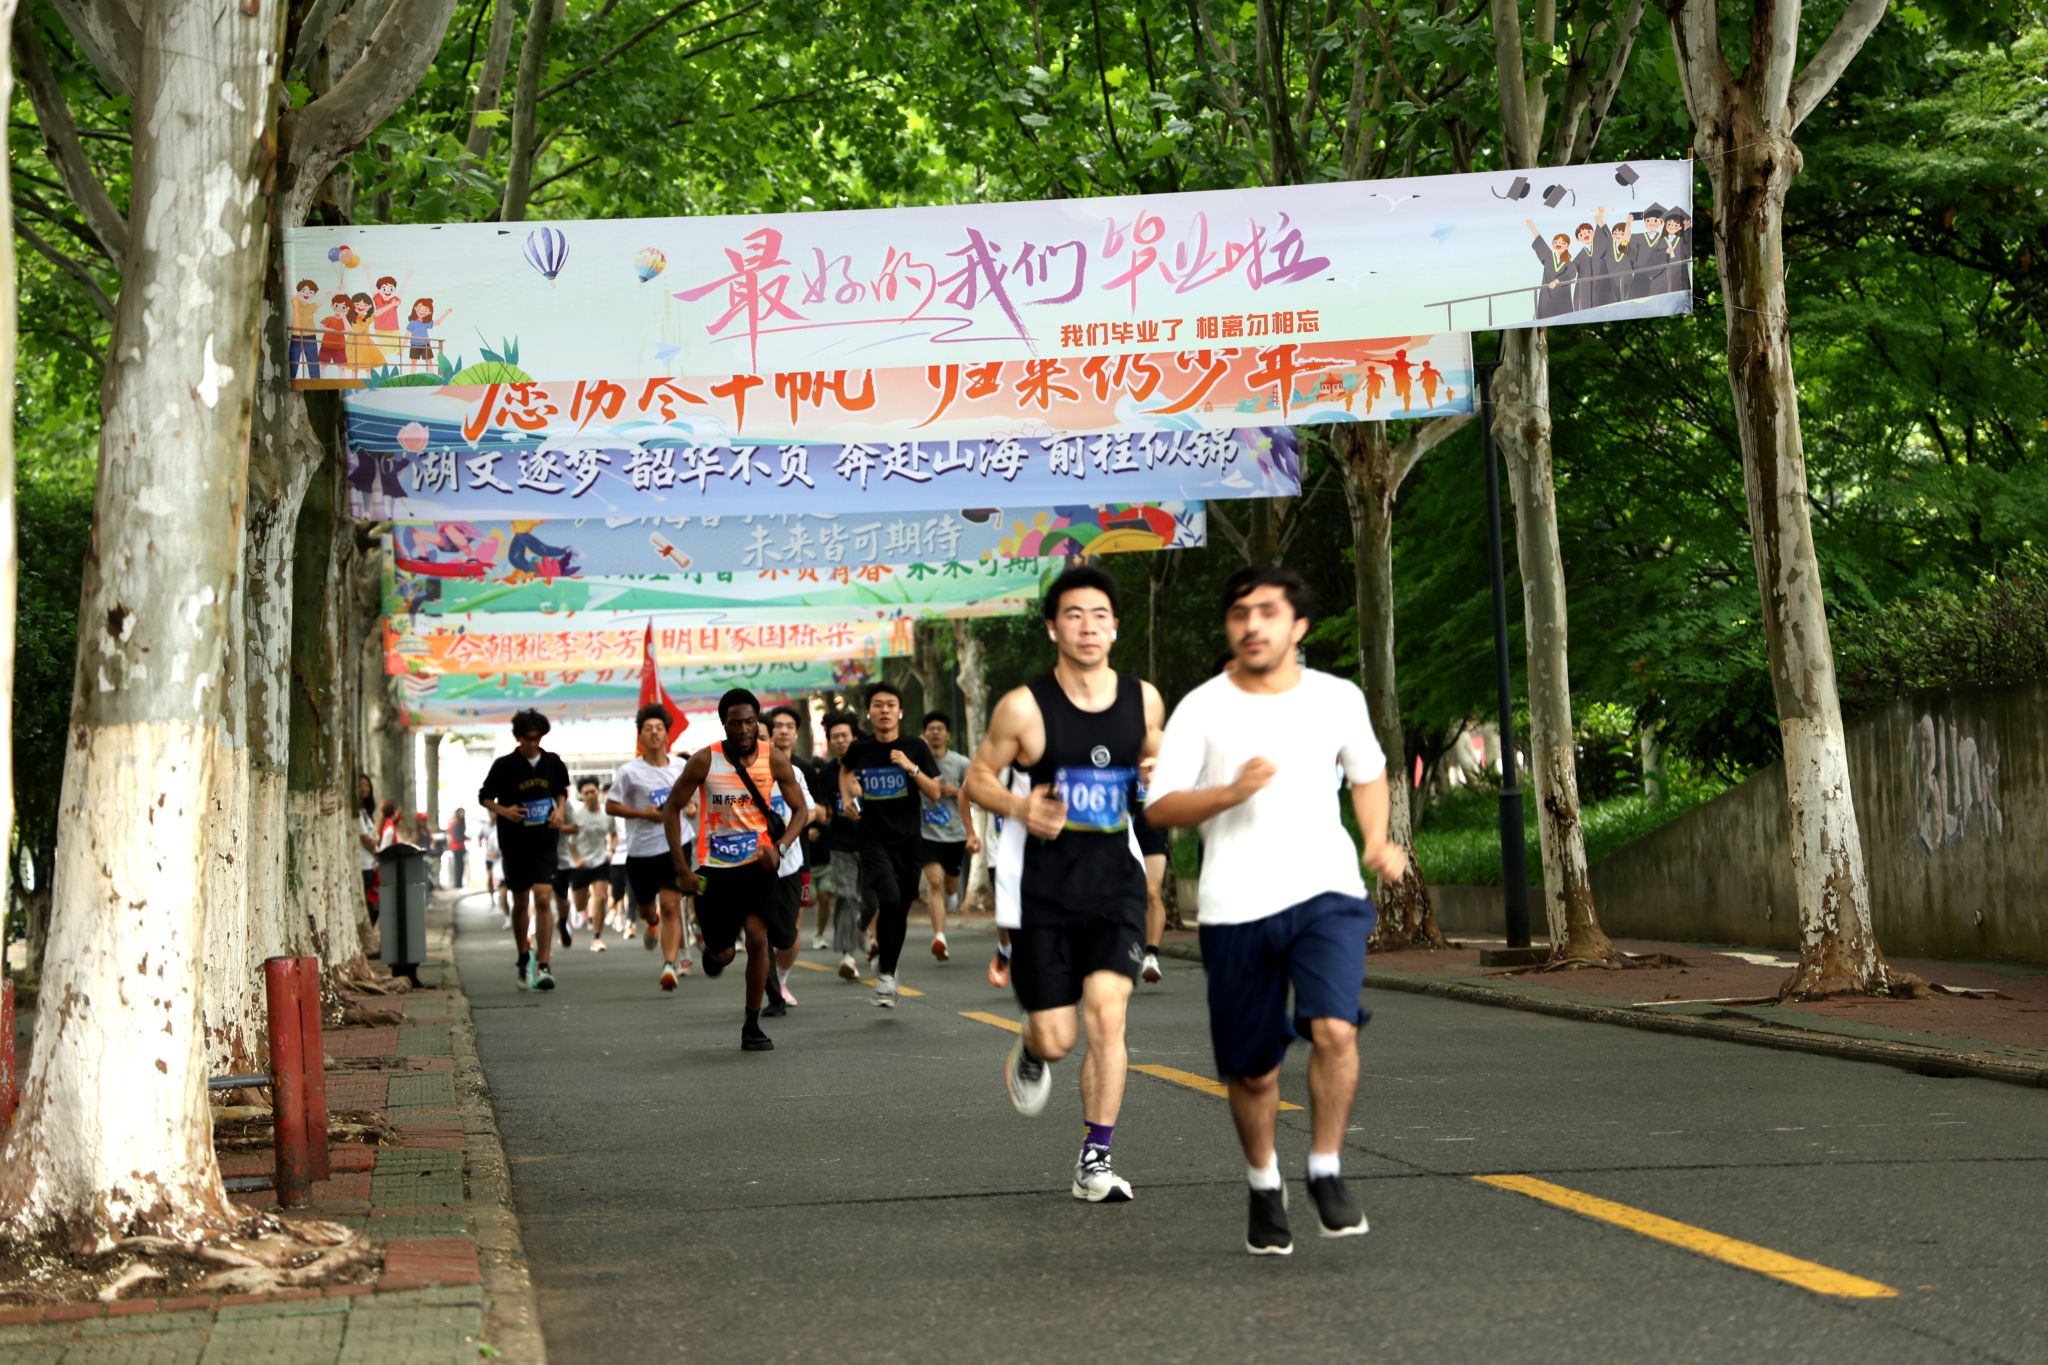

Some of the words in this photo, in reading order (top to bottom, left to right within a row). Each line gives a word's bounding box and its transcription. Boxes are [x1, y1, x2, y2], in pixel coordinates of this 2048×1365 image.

[672, 209, 1331, 374] 最好的我们毕业啦
[1060, 317, 1184, 348] 我们毕业了
[1196, 309, 1320, 340] 相离勿相忘
[412, 450, 612, 498] 湖文逐梦
[622, 444, 815, 495] 韶华不负
[836, 438, 1029, 490] 奔赴山海
[1040, 427, 1240, 479] 前程似锦
[742, 513, 963, 569] 未来皆可期待
[446, 629, 643, 666] 今朝桃李芬芳
[712, 794, 756, 806] 国际学
[863, 774, 905, 790] 10190
